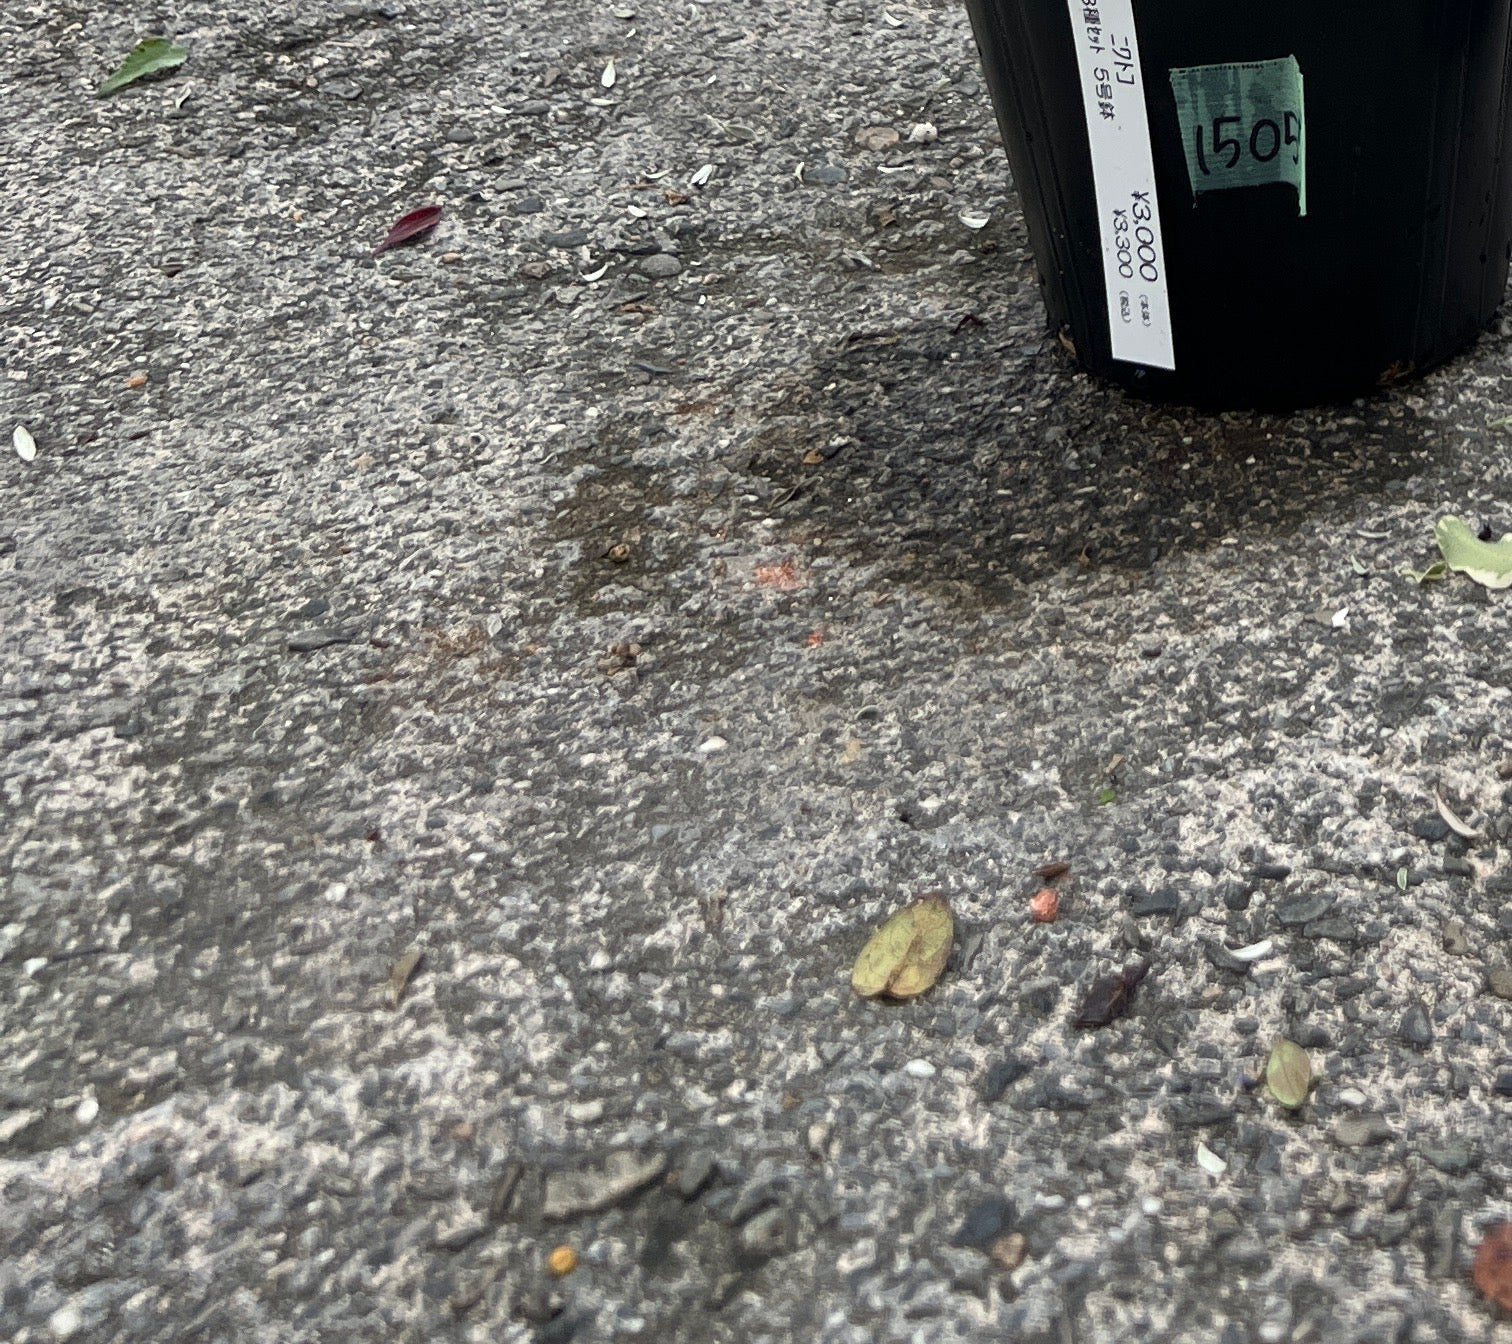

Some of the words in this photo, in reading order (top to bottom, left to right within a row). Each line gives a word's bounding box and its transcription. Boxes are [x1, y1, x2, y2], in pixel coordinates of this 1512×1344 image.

[1109, 35, 1136, 86] ニワトコ
[1093, 67, 1115, 121] 5号鉢
[1112, 208, 1134, 280] ¥3,300
[1131, 189, 1159, 282] ¥3,000
